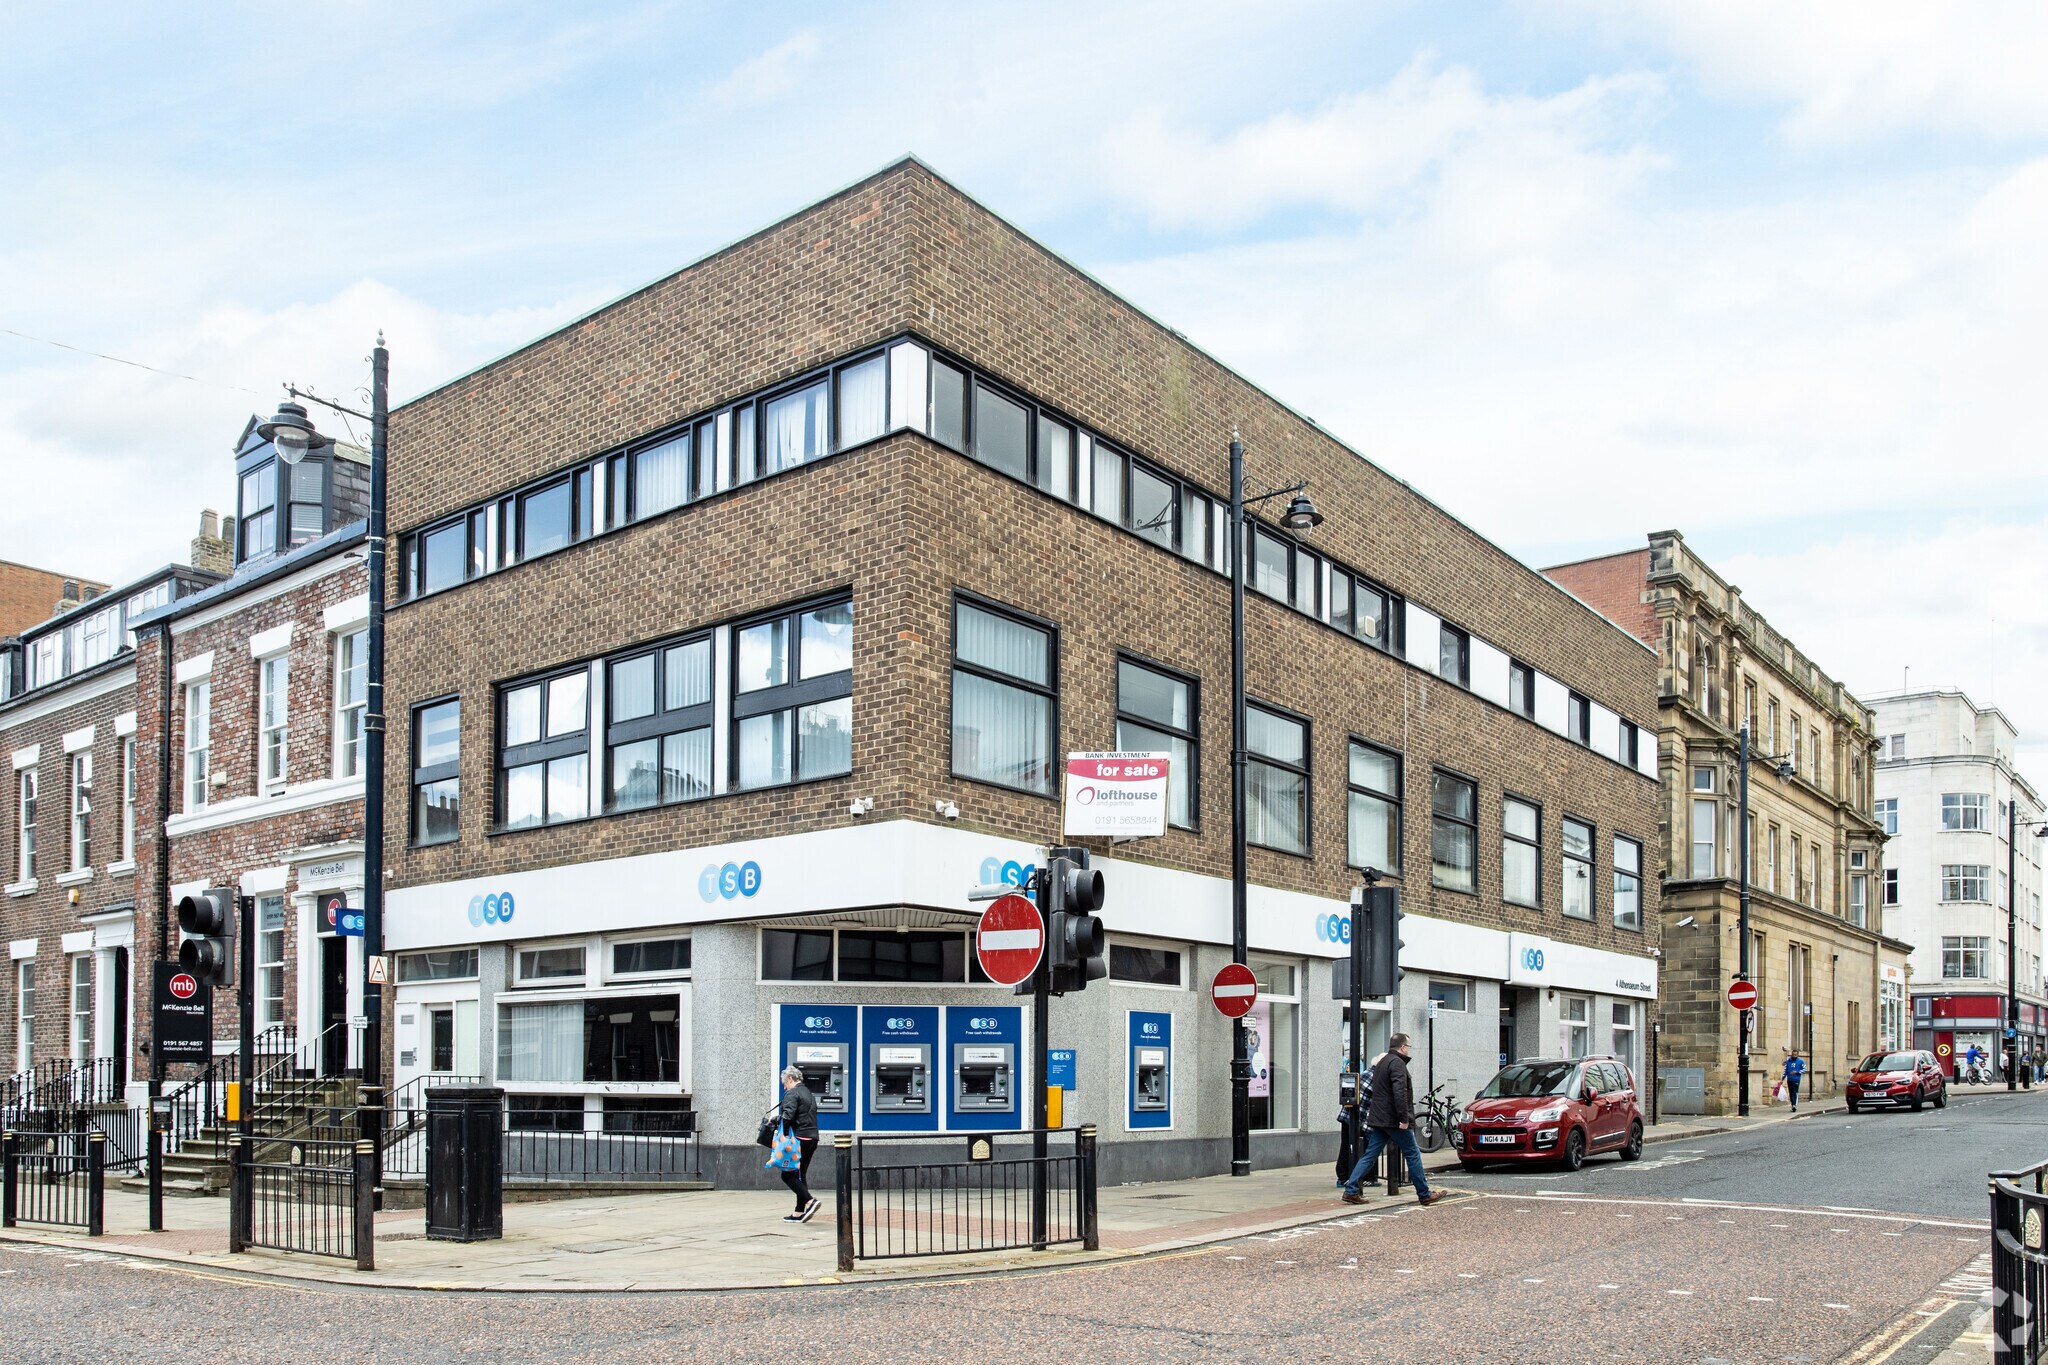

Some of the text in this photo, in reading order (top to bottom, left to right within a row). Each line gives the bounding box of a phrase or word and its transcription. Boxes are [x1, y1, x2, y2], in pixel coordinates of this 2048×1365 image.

[1096, 763, 1159, 776] for sale
[1096, 789, 1158, 800] lofthouse
[1094, 816, 1157, 825] 0191 5658844
[335, 862, 345, 873] Bell
[703, 867, 757, 896] TSB
[472, 897, 512, 921] TSB
[1319, 919, 1350, 940] TSB
[1522, 952, 1543, 969] TSB
[173, 979, 194, 991] mb
[1615, 979, 1619, 987] 4
[1640, 982, 1652, 992] Street
[807, 1018, 831, 1027] TSB
[889, 1019, 913, 1028] TSB
[972, 1019, 996, 1028] TSB
